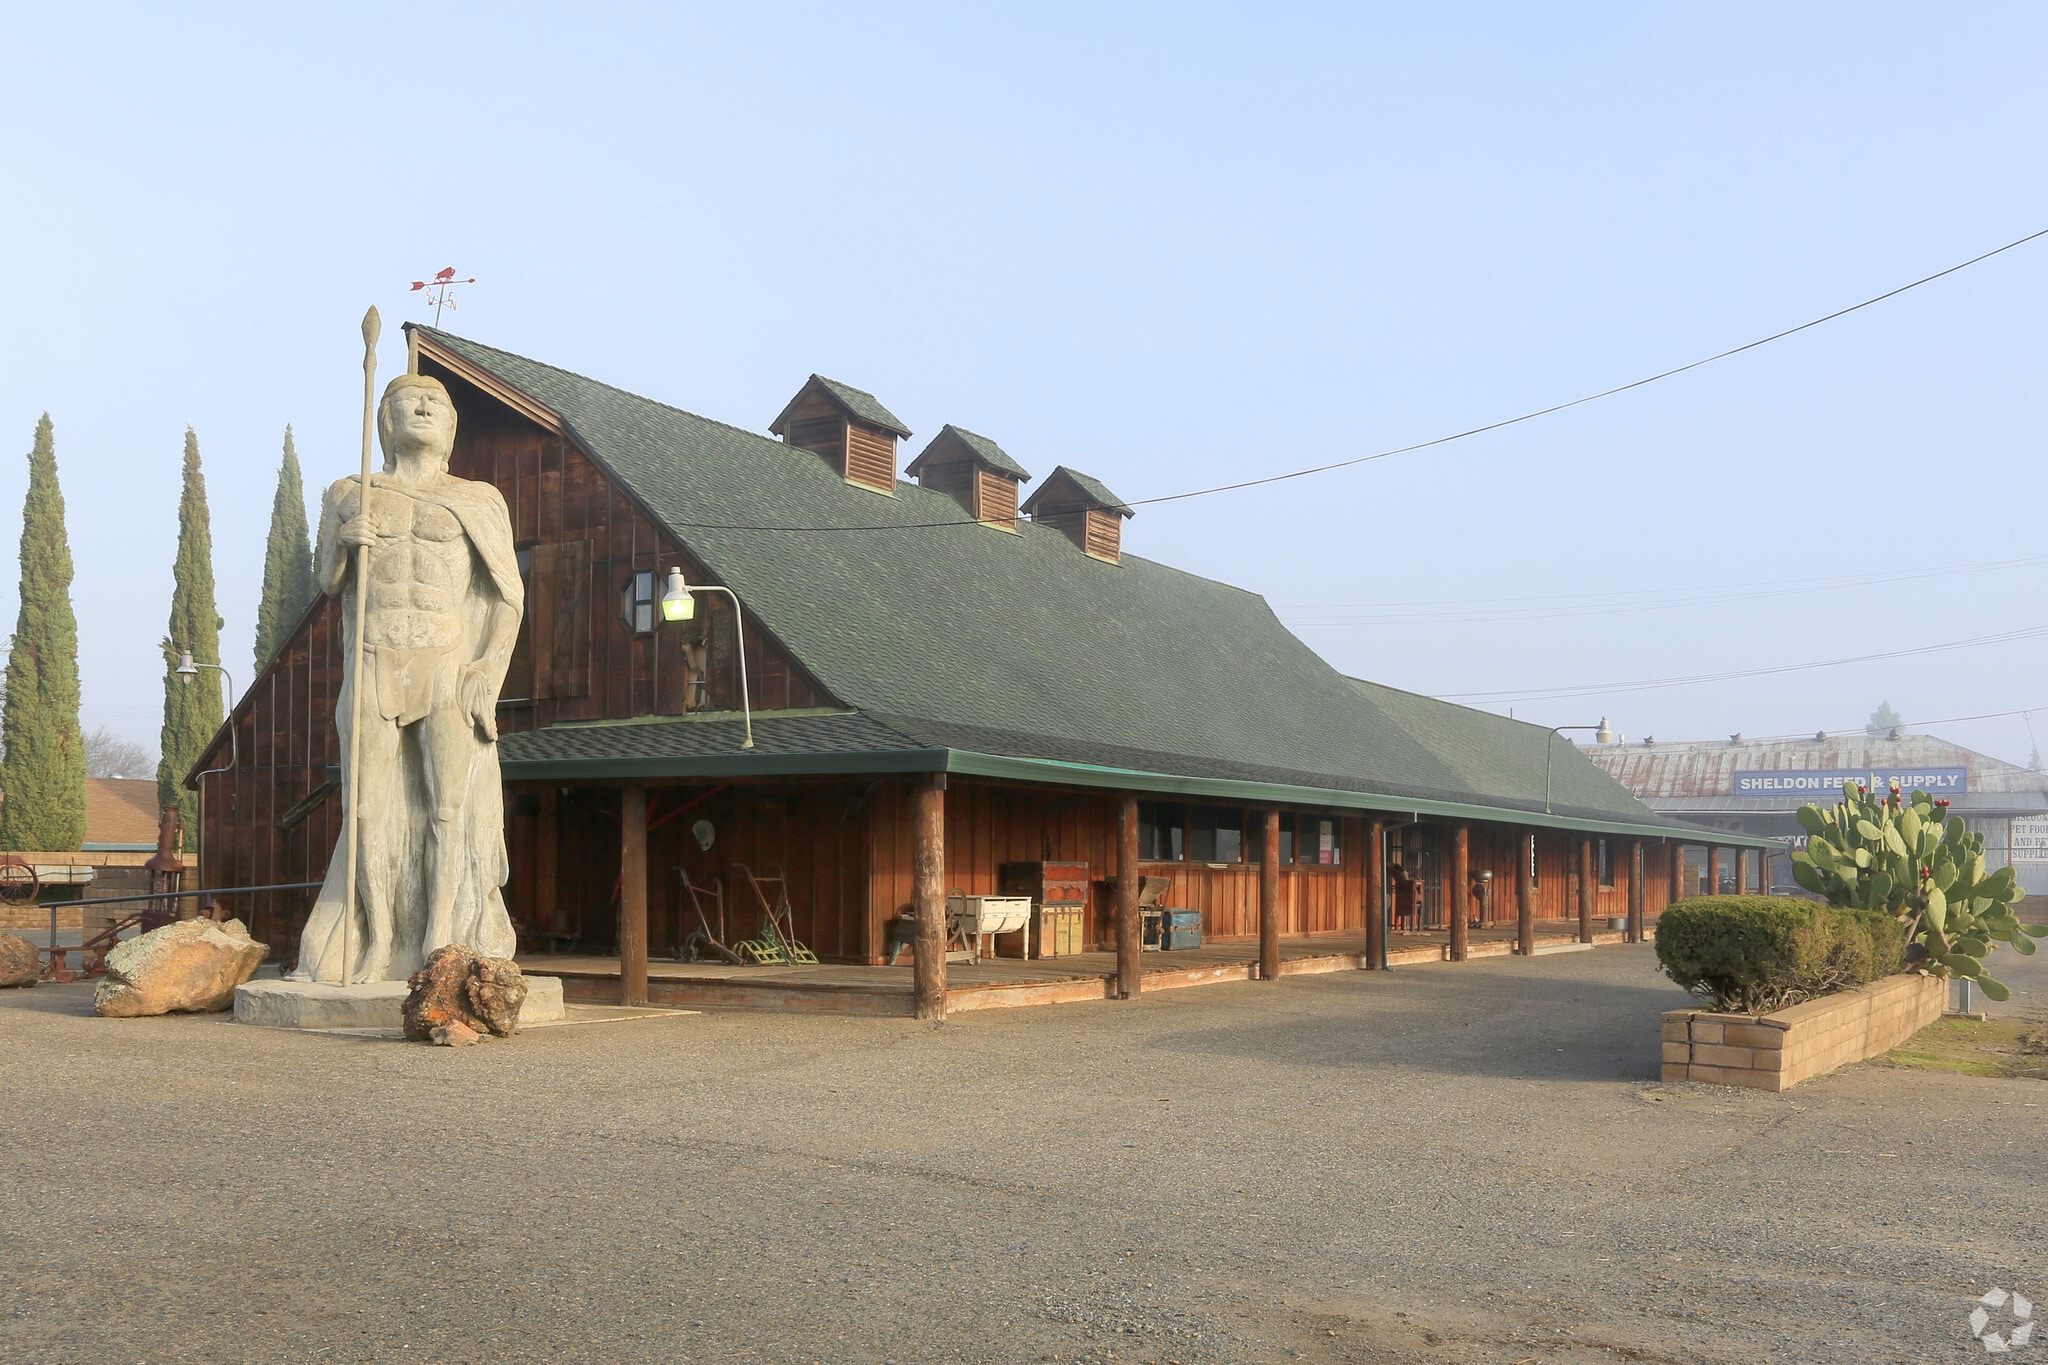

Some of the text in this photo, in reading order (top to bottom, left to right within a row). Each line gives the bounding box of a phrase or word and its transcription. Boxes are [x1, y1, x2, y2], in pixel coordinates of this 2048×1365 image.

[1740, 776, 1819, 790] SHELDON
[1874, 776, 1885, 788] &
[2011, 825, 2026, 833] PET
[2014, 837, 2048, 846] AND PE
